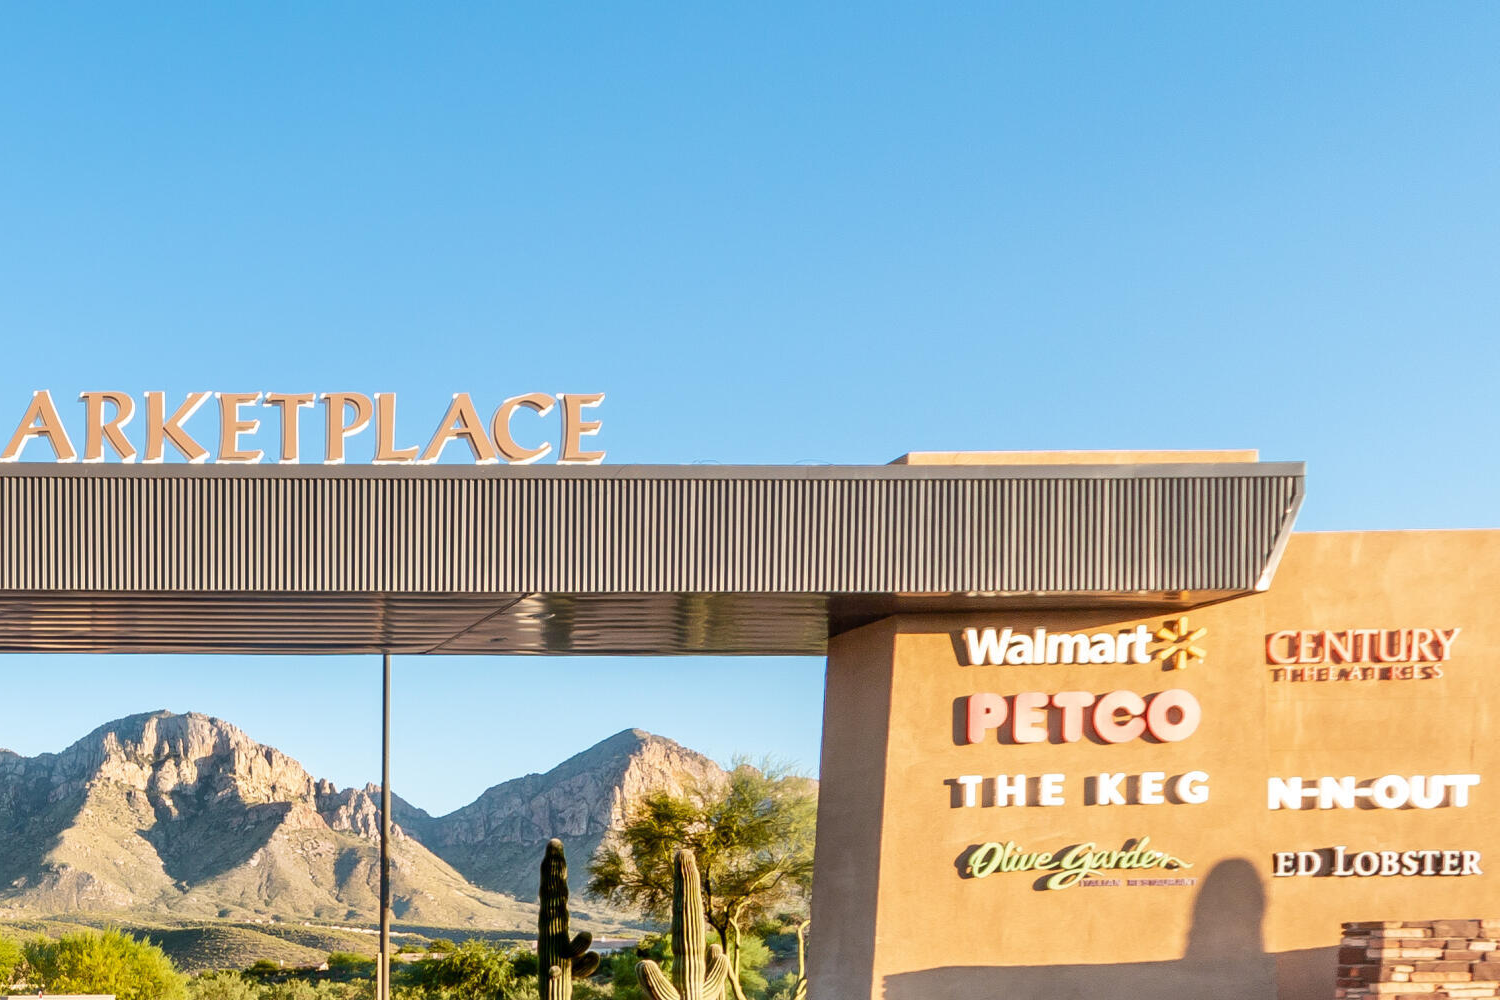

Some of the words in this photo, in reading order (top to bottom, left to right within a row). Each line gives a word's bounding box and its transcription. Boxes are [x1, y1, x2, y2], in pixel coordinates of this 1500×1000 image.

[963, 625, 1153, 665] Walmart
[1266, 628, 1462, 664] CENTURY
[1283, 664, 1445, 681] THEATRES
[967, 689, 1201, 743] PETCO
[957, 773, 1066, 807] THE
[1096, 770, 1210, 806] KEG
[1267, 774, 1481, 809] N-N-OUT
[969, 840, 1060, 878] Olive
[1047, 836, 1194, 890] Garden
[1273, 851, 1322, 877] ED
[1331, 846, 1484, 877] LOBSTER
